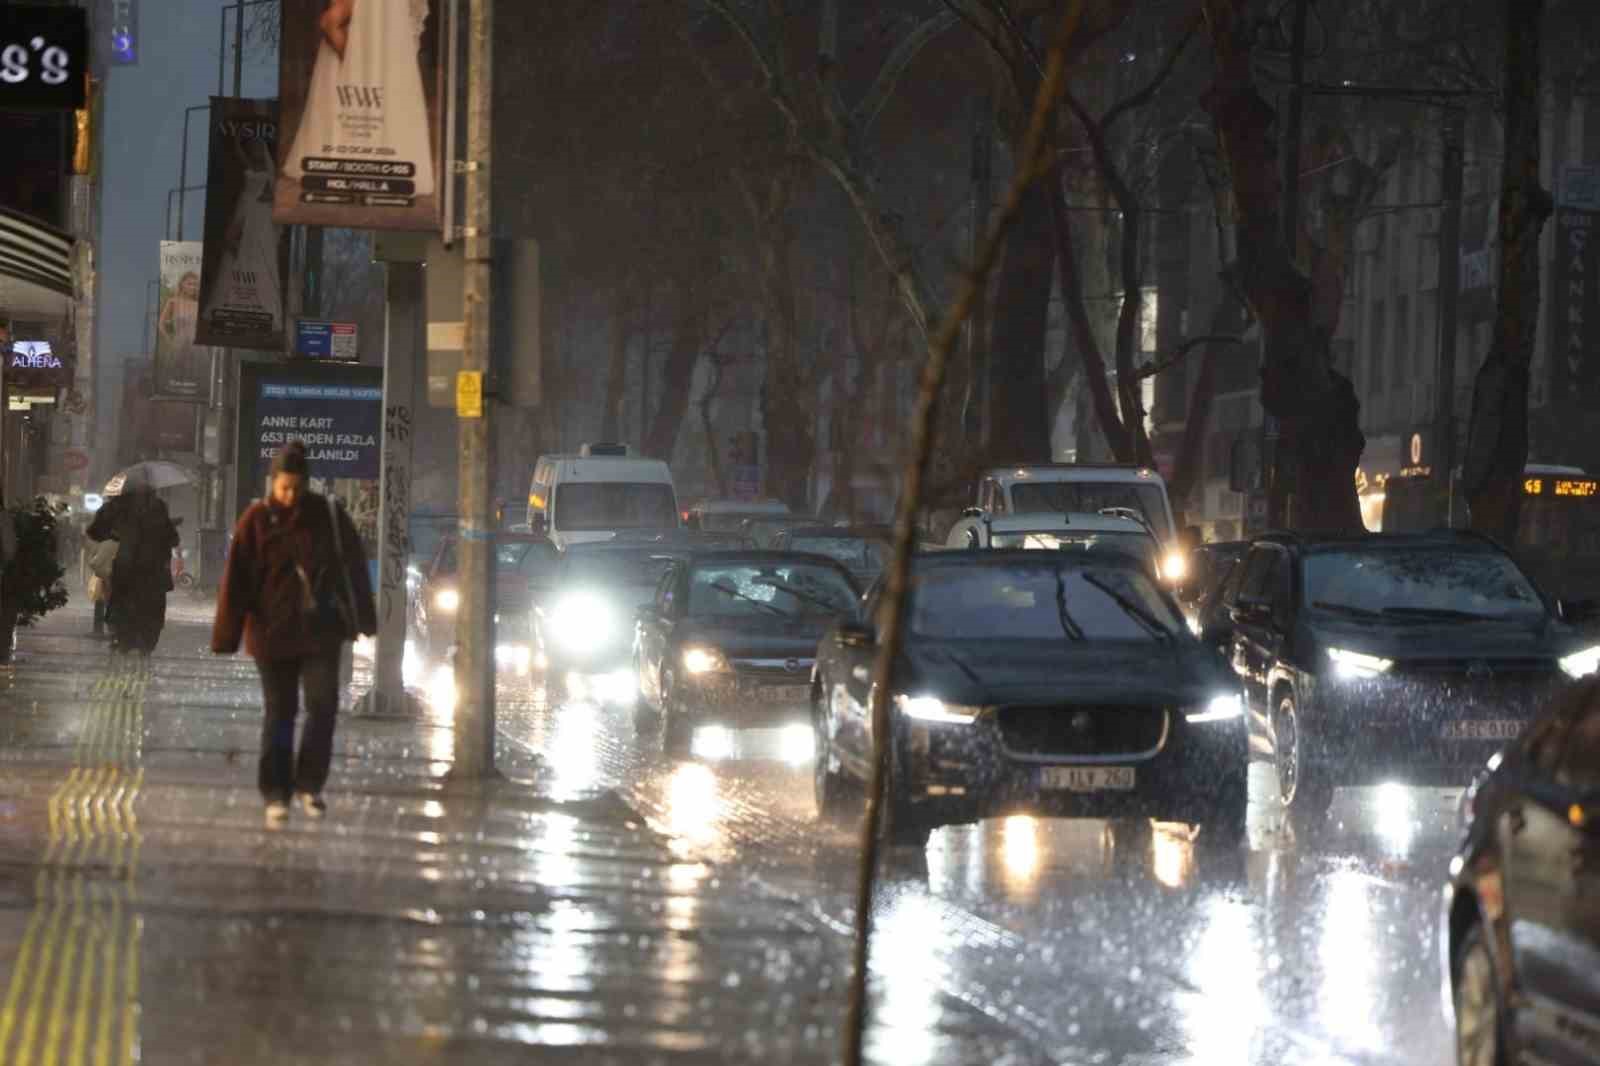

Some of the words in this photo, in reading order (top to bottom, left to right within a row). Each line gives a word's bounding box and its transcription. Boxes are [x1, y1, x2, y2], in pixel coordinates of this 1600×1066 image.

[261, 416, 297, 428] ANNE
[300, 417, 334, 430] KART
[260, 431, 284, 443] 653
[336, 433, 376, 446] FAZLA
